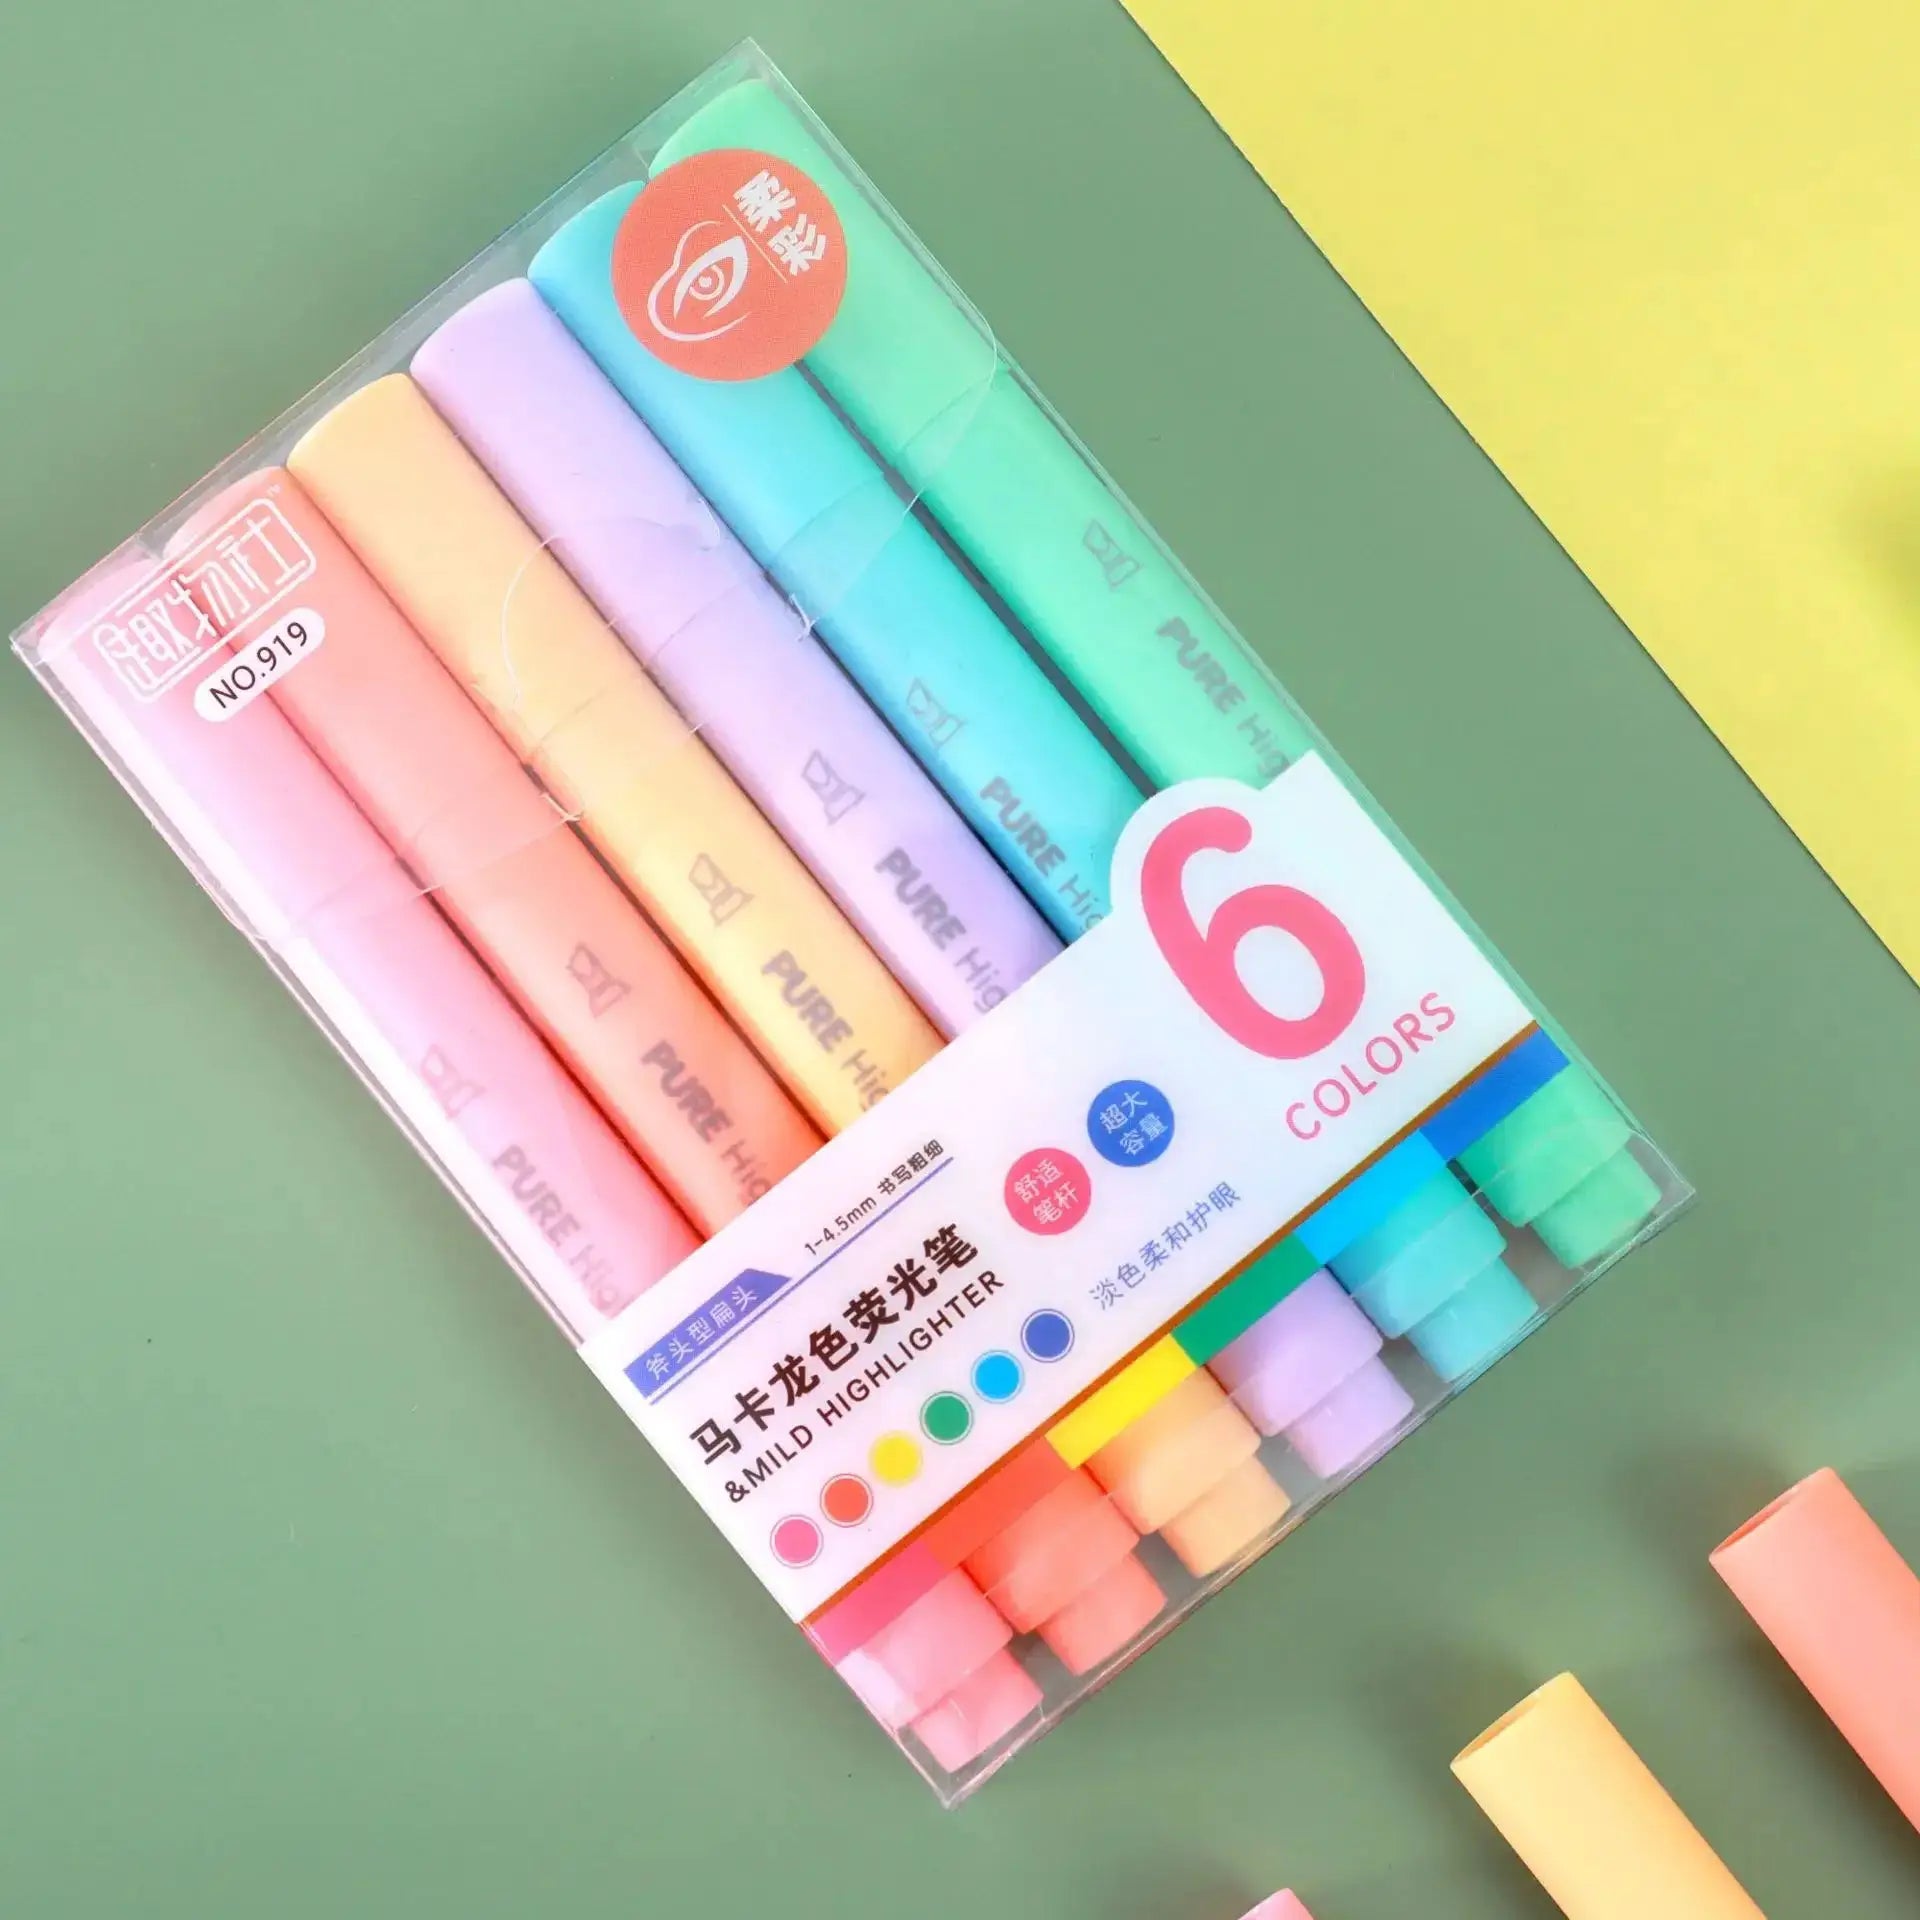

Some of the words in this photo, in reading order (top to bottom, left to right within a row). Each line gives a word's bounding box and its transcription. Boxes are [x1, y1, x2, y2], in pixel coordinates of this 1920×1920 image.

[732, 169, 827, 276] 柔彩
[209, 621, 308, 708] NO.919
[1156, 616, 1247, 715] PURE
[978, 777, 1066, 877] PURE
[873, 845, 967, 952] PURE
[1140, 806, 1366, 1060] 6
[761, 949, 854, 1054] PURE
[641, 1039, 733, 1143] PURE
[1099, 1090, 1148, 1134] 超大
[1285, 991, 1457, 1140] COLORS
[1013, 1158, 1064, 1204] 舒适
[1119, 1113, 1169, 1156] 容量
[492, 1144, 581, 1248] PURE
[804, 1196, 877, 1257] 1-4.5mm
[876, 1138, 945, 1196] 书写粗细
[1031, 1182, 1079, 1226] 笔杆
[1088, 1180, 1243, 1311] 淡色柔和护眼
[645, 1284, 758, 1381] 斧头型扁头
[689, 1222, 979, 1465] 马卡龙色荧光笔
[723, 1423, 815, 1503] &MILD
[817, 1269, 1005, 1428] HIGHLIGHTER
